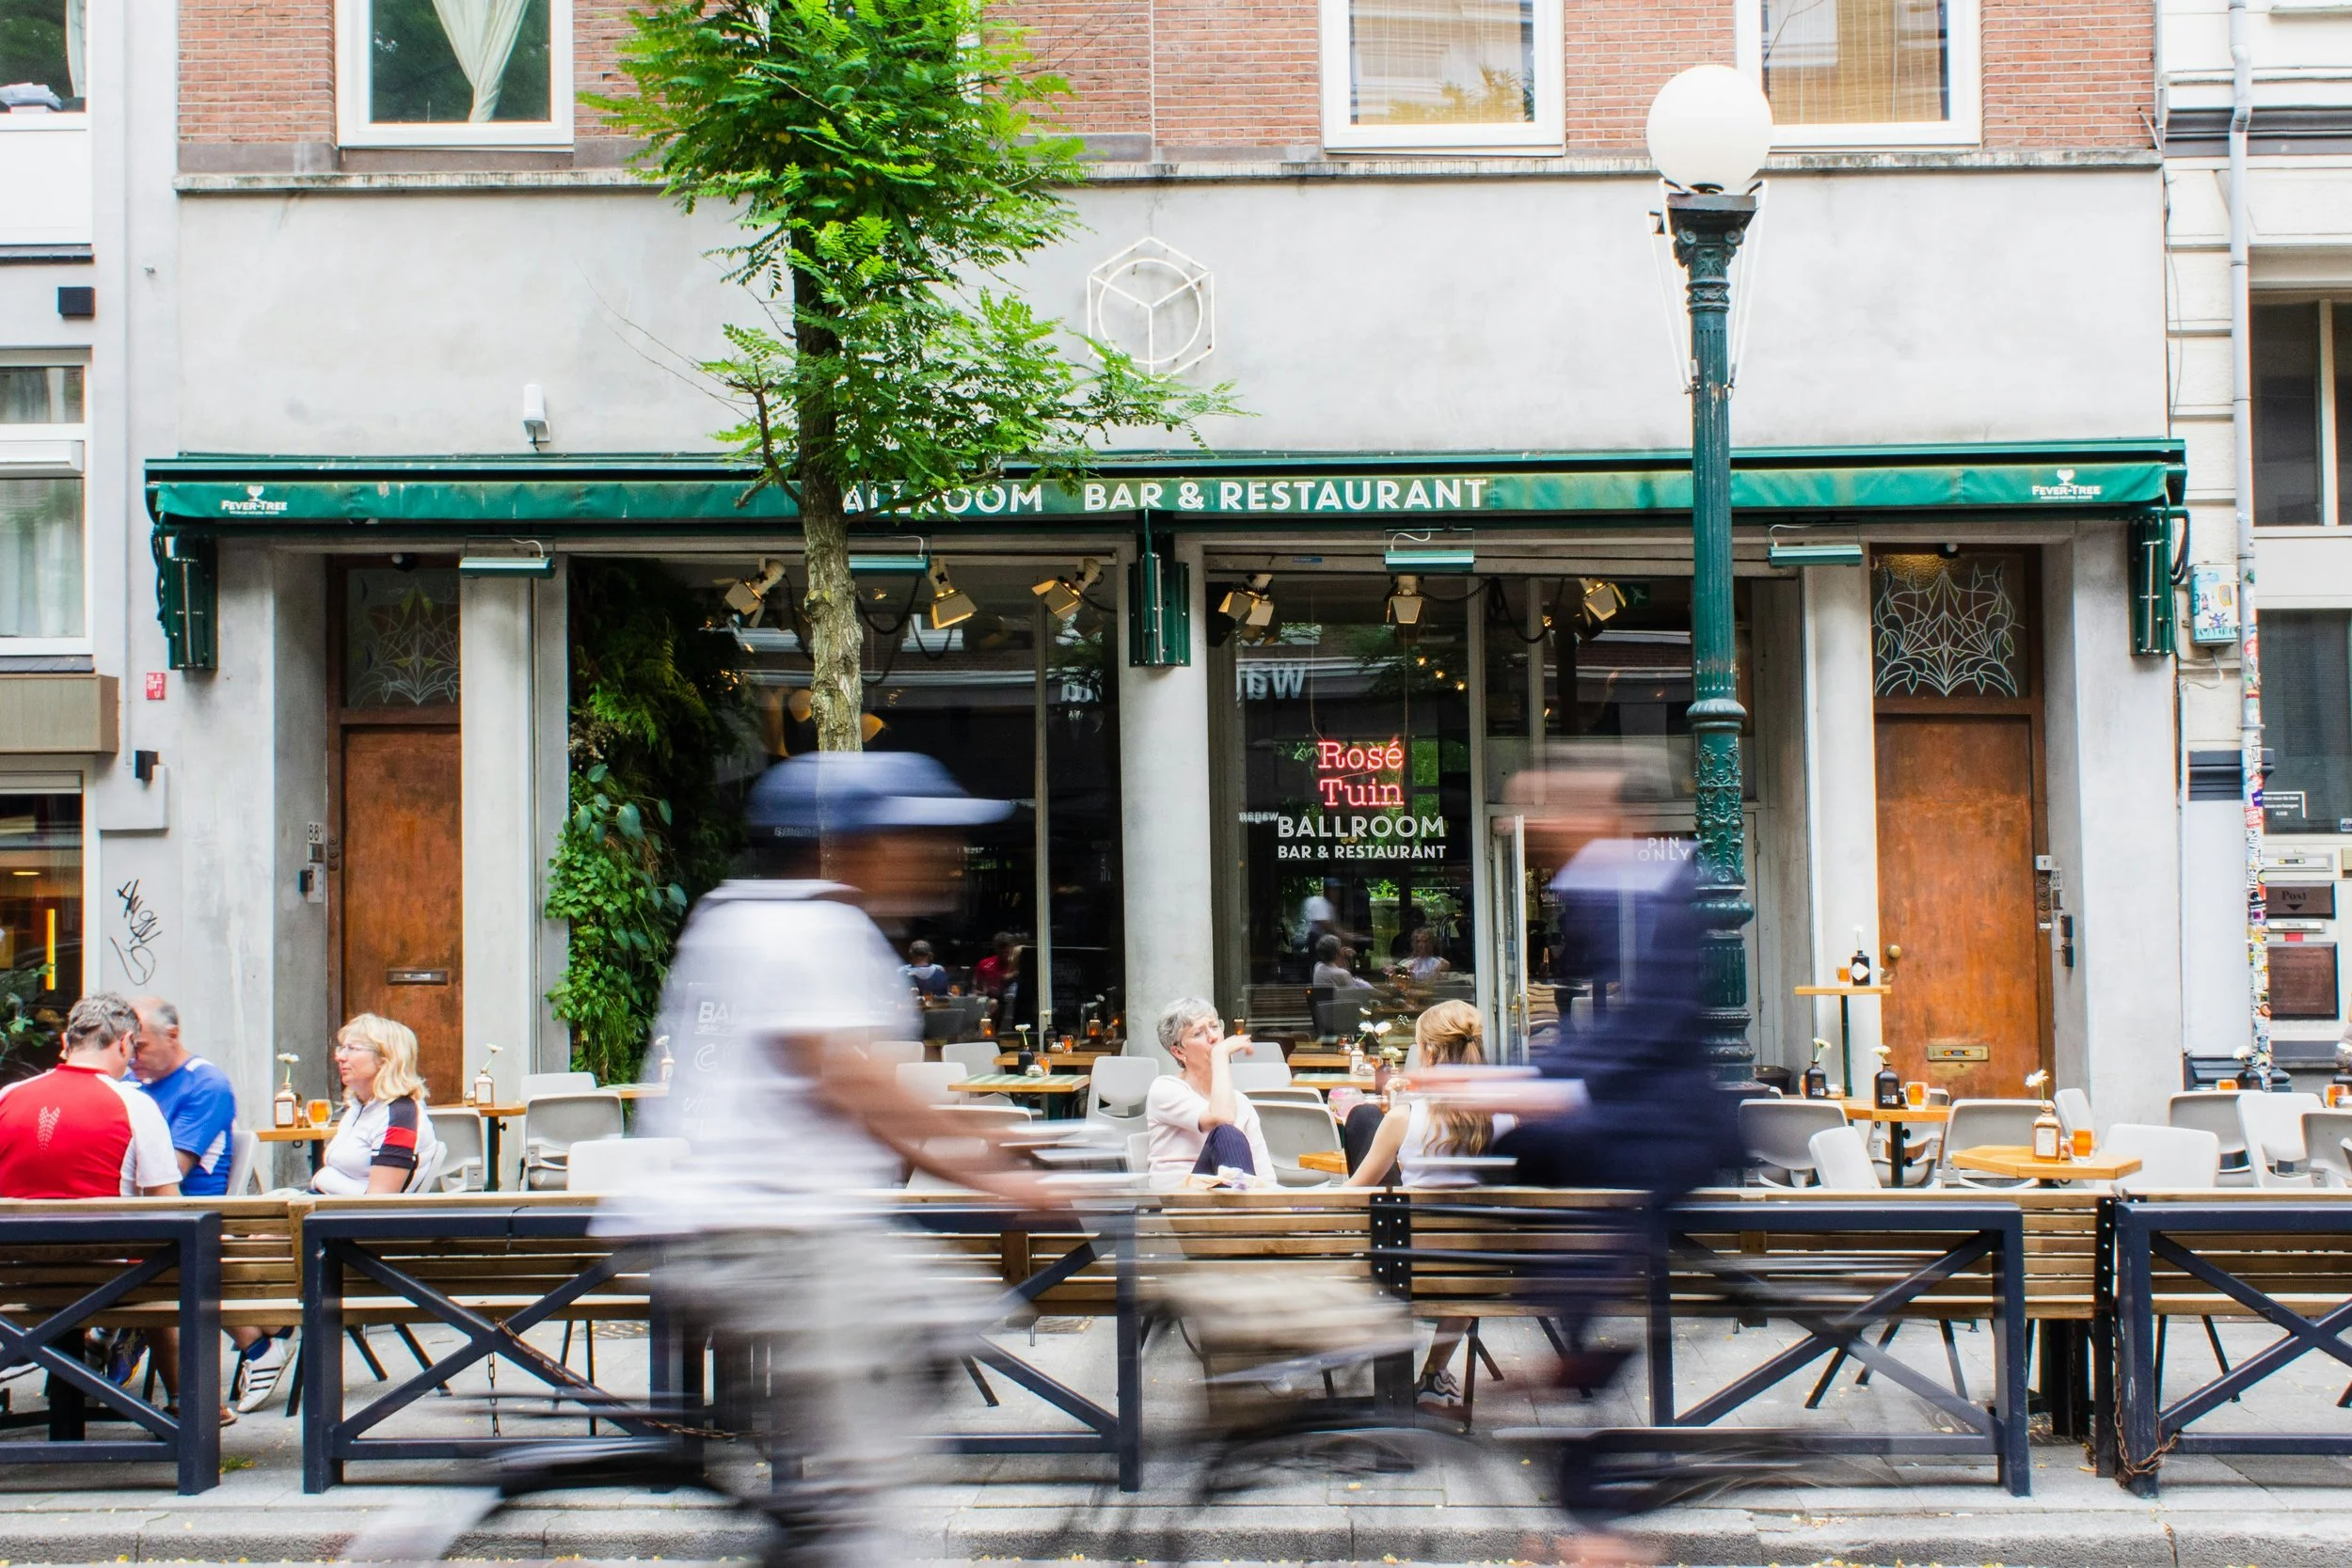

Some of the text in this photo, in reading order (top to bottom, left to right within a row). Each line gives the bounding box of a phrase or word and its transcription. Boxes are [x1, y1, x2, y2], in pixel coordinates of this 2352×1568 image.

[1084, 482, 1162, 510] BAR
[1178, 481, 1206, 509] &
[1221, 478, 1487, 511] RESTAURANT
[2032, 485, 2101, 495] FEVER-TREE
[221, 500, 288, 511] FEVER-TREE
[1317, 739, 1404, 769] Rosé
[1319, 778, 1405, 807] Tuin
[1278, 816, 1445, 837] BALLROOM
[1648, 837, 1679, 848] PIN
[1278, 846, 1447, 859] BAR & RESTAURANT
[1638, 848, 1690, 861] ONLY
[2281, 891, 2308, 901] Post
